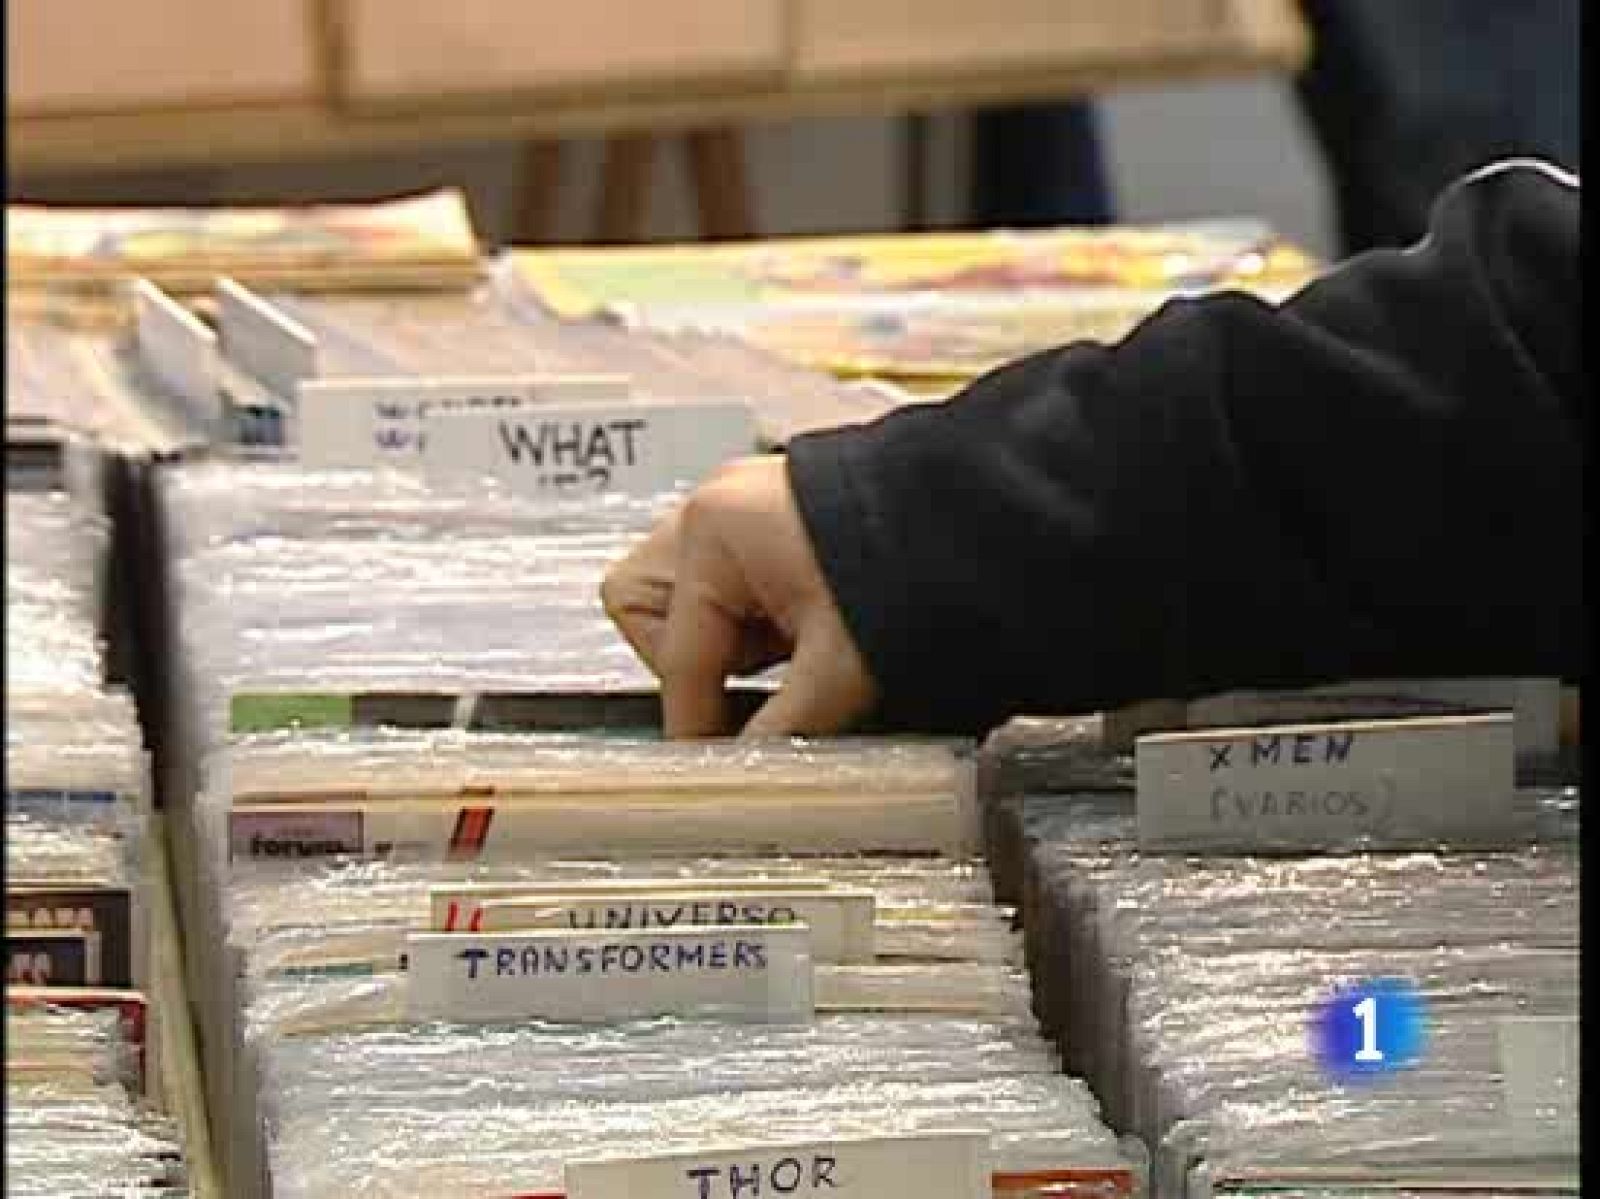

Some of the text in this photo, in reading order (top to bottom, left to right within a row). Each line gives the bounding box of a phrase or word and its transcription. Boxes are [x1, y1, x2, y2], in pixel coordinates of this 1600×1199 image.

[500, 418, 646, 466] WHAT
[1252, 733, 1354, 767] MEN
[456, 941, 769, 979] TRANSFORMERS
[687, 1157, 838, 1199] THOR
